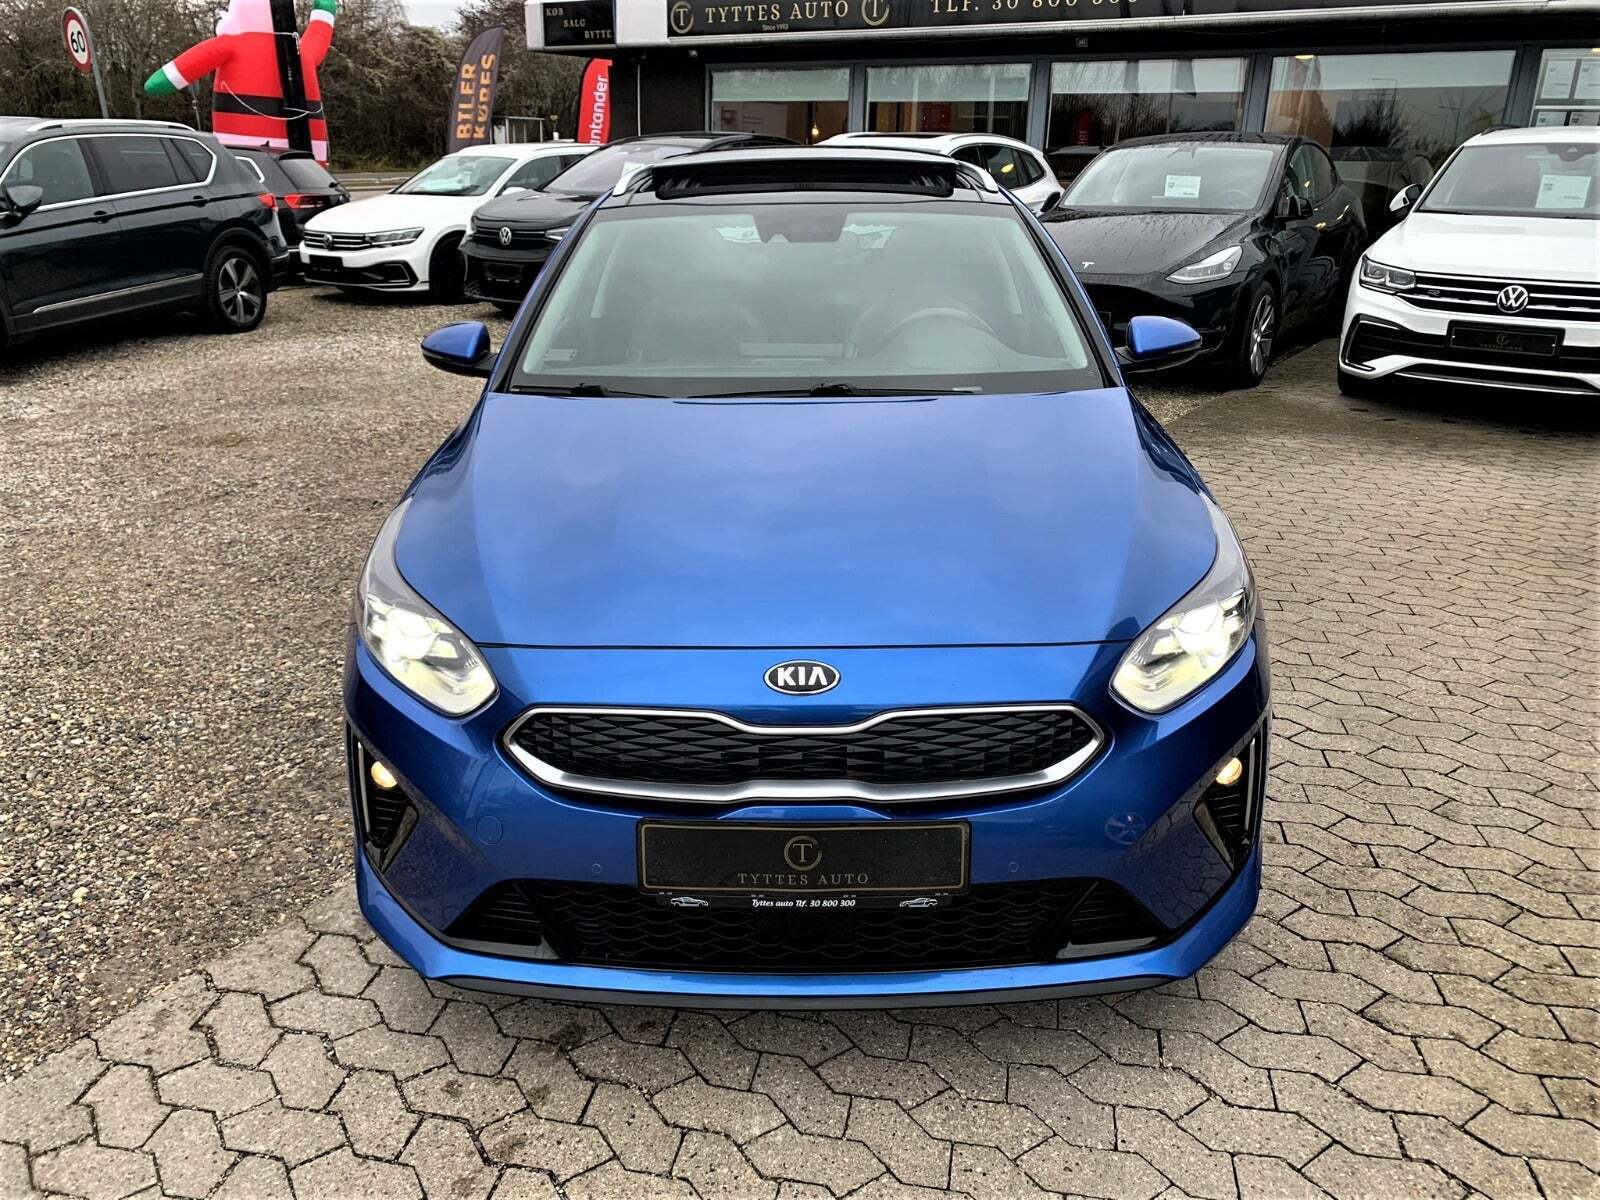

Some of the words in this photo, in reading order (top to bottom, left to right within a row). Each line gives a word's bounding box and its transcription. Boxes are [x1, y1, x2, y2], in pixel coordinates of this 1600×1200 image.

[705, 3, 781, 24] TYTTES
[789, 0, 849, 20] AUTO
[563, 18, 586, 28] SALG
[584, 30, 613, 39] BYTTE
[70, 30, 86, 53] 60
[777, 666, 828, 686] KIA
[737, 873, 808, 886] TYTTES
[818, 873, 869, 885] AUTO
[752, 899, 774, 908] Tyttes
[809, 899, 821, 908] 30
[821, 899, 839, 908] 800
[839, 899, 856, 908] 300
